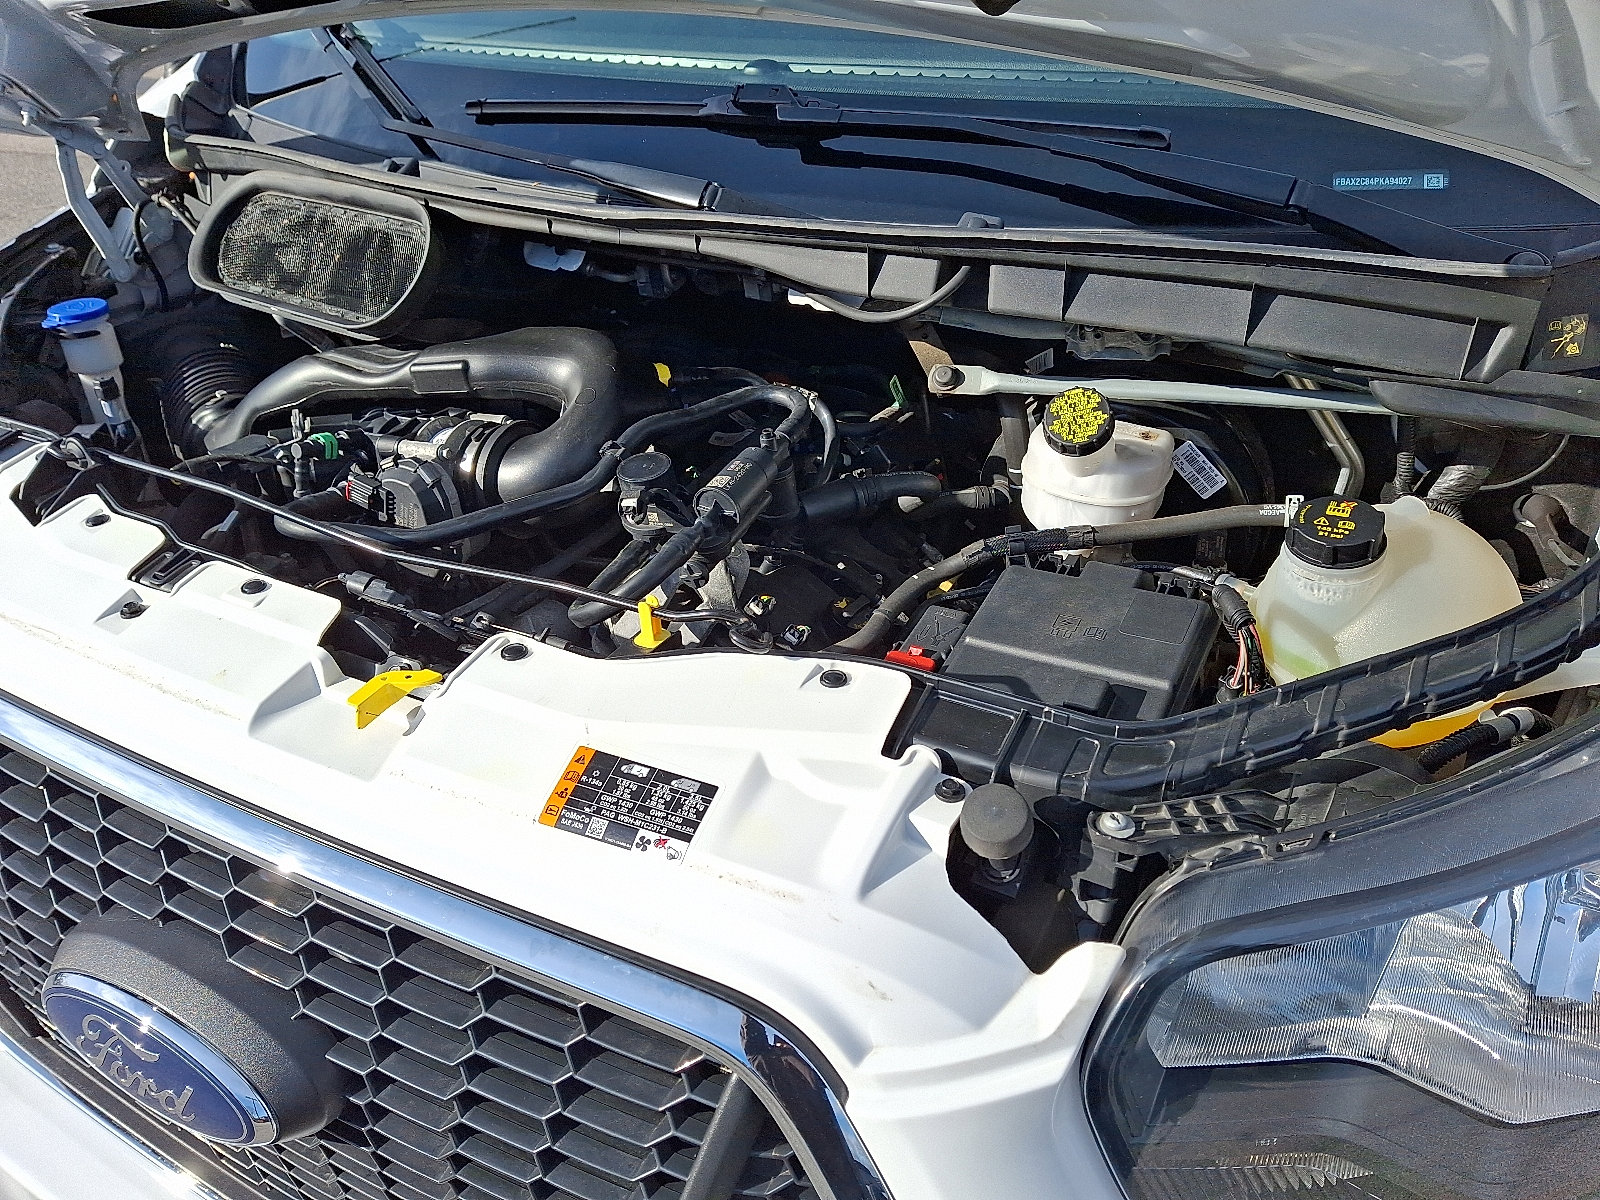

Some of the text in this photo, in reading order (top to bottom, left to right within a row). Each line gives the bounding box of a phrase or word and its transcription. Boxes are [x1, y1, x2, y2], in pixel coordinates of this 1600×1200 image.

[580, 775, 603, 787] R-134a
[600, 794, 633, 808] GWP 1430
[695, 803, 704, 811] kg
[560, 809, 590, 823] FoMoCo
[600, 809, 668, 834] PAG WSH-M1C231-B
[648, 809, 683, 823] GWP 1430
[76, 1014, 196, 1122] Ford
